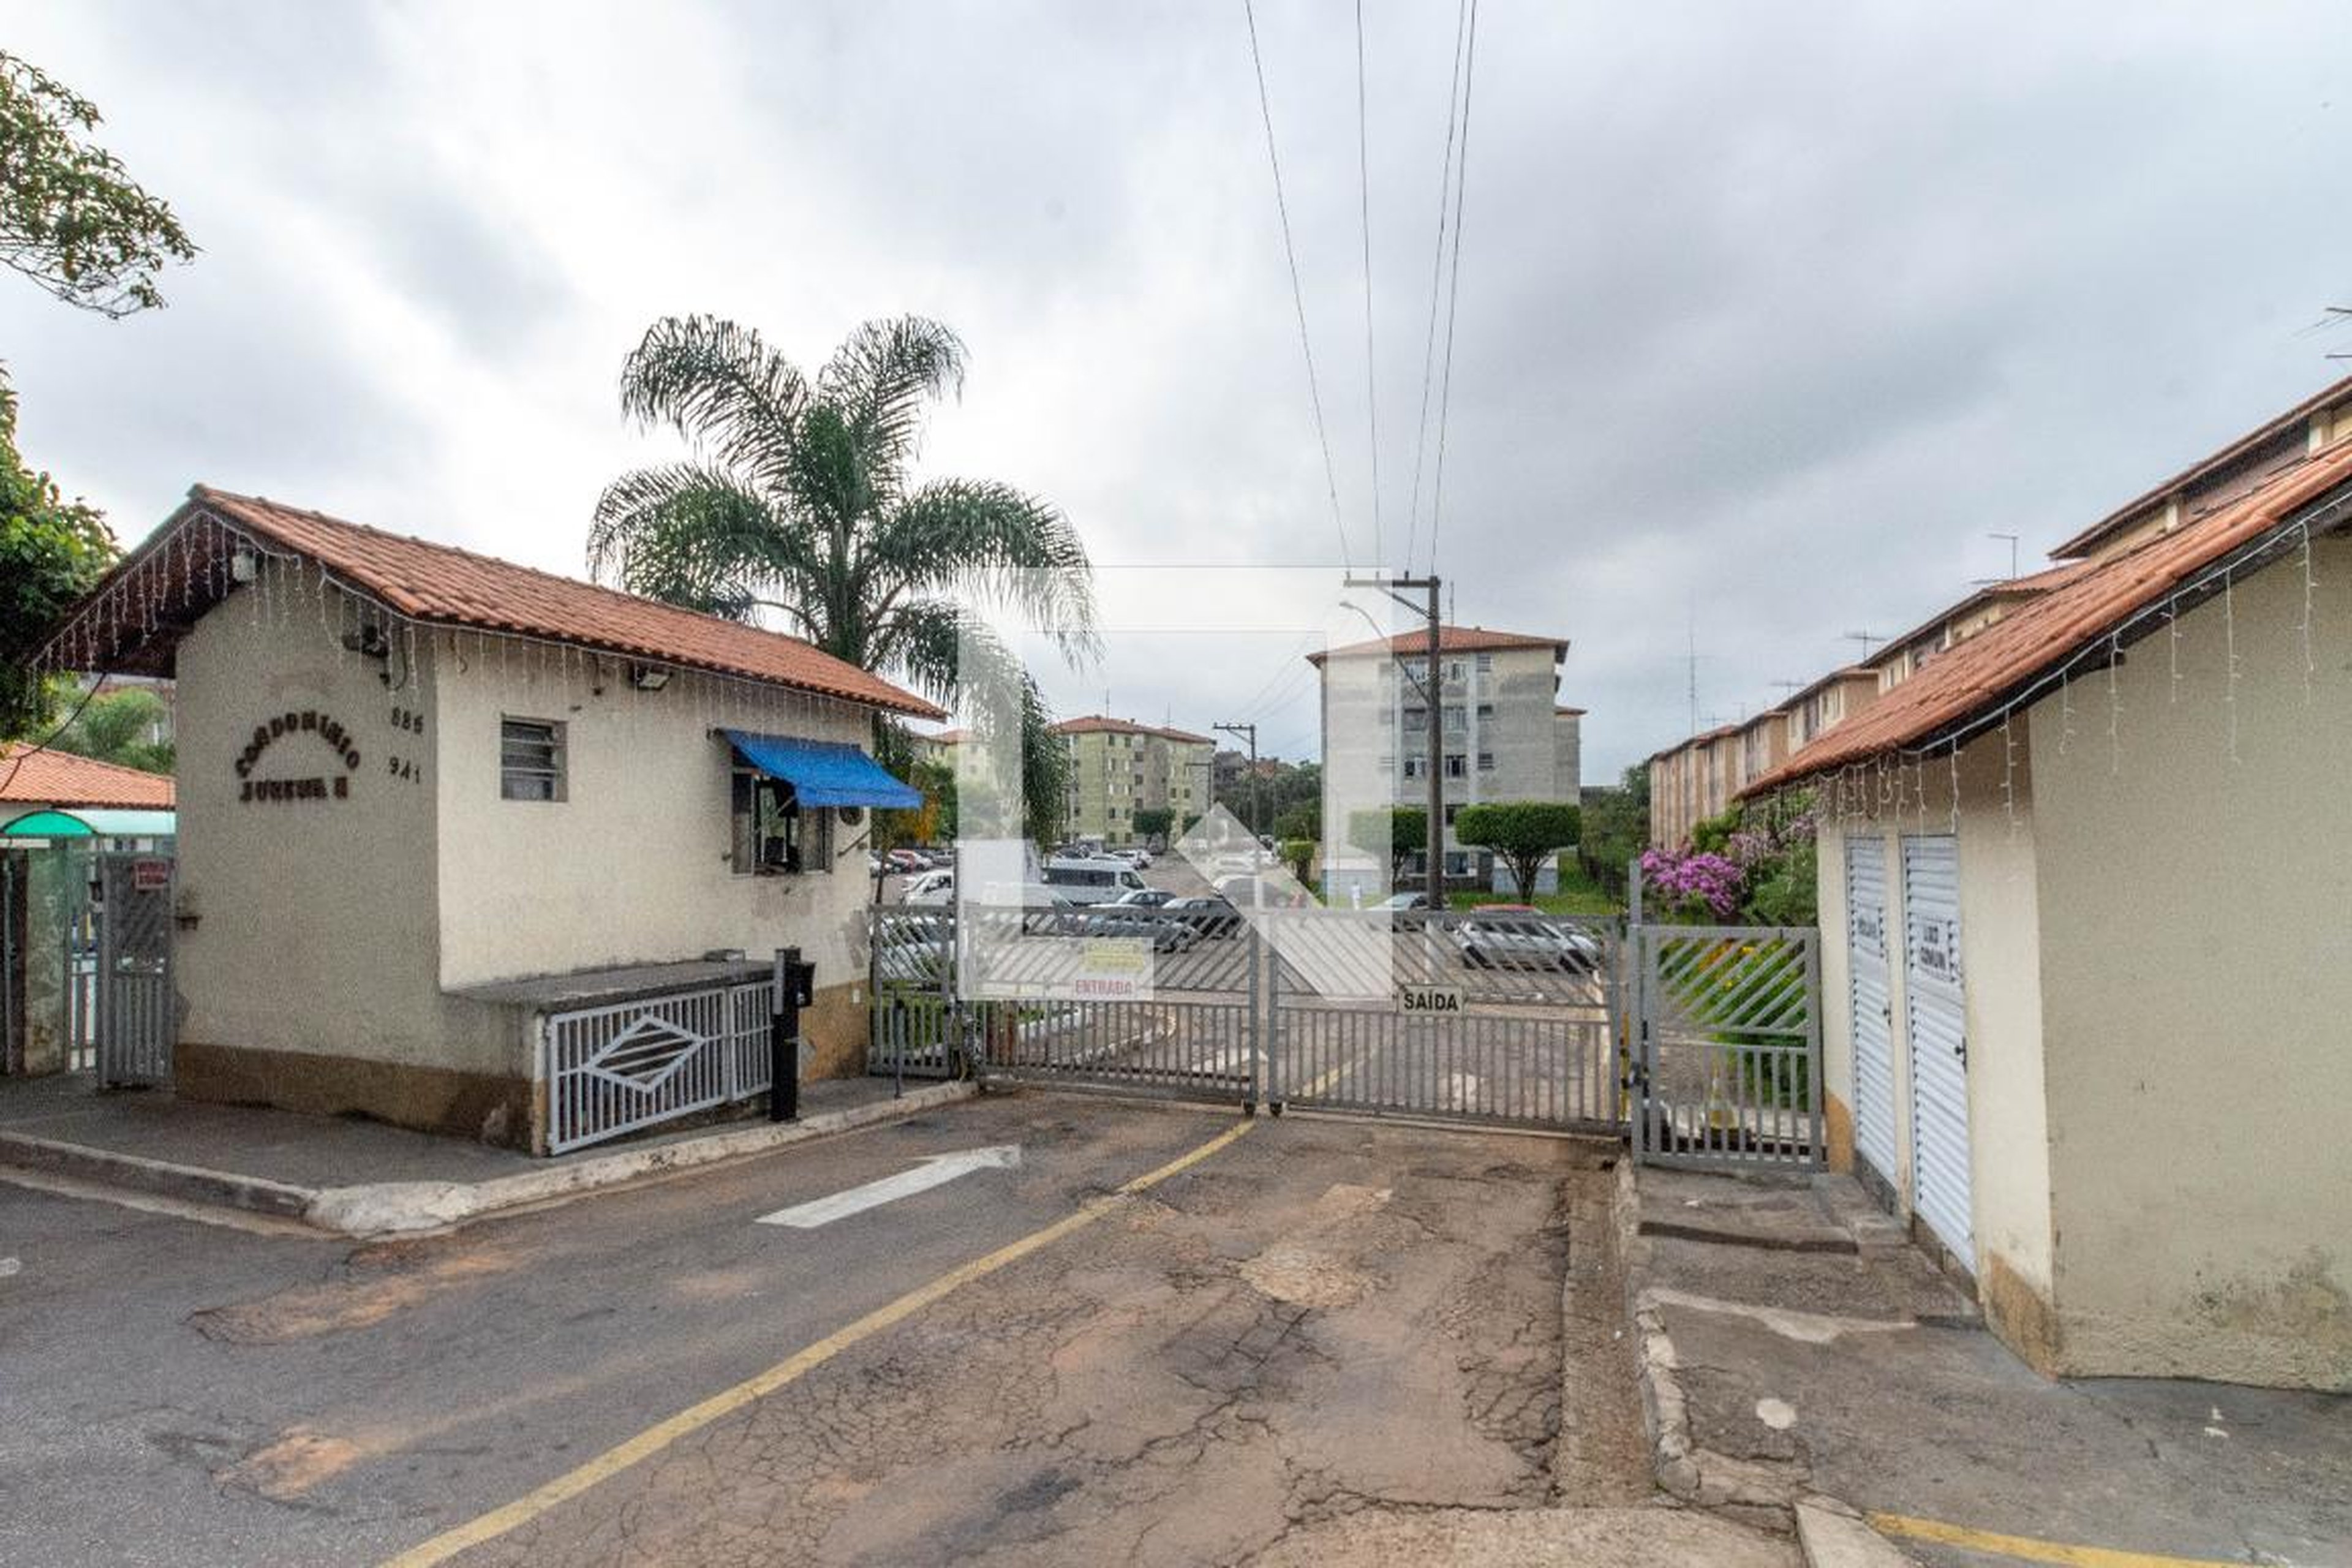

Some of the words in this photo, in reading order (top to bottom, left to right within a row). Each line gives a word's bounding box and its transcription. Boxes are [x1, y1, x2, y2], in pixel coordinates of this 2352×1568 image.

[390, 757, 420, 784] 941
[1076, 979, 1133, 995] ENTRADA
[1403, 989, 1459, 1011] SAÍDA
